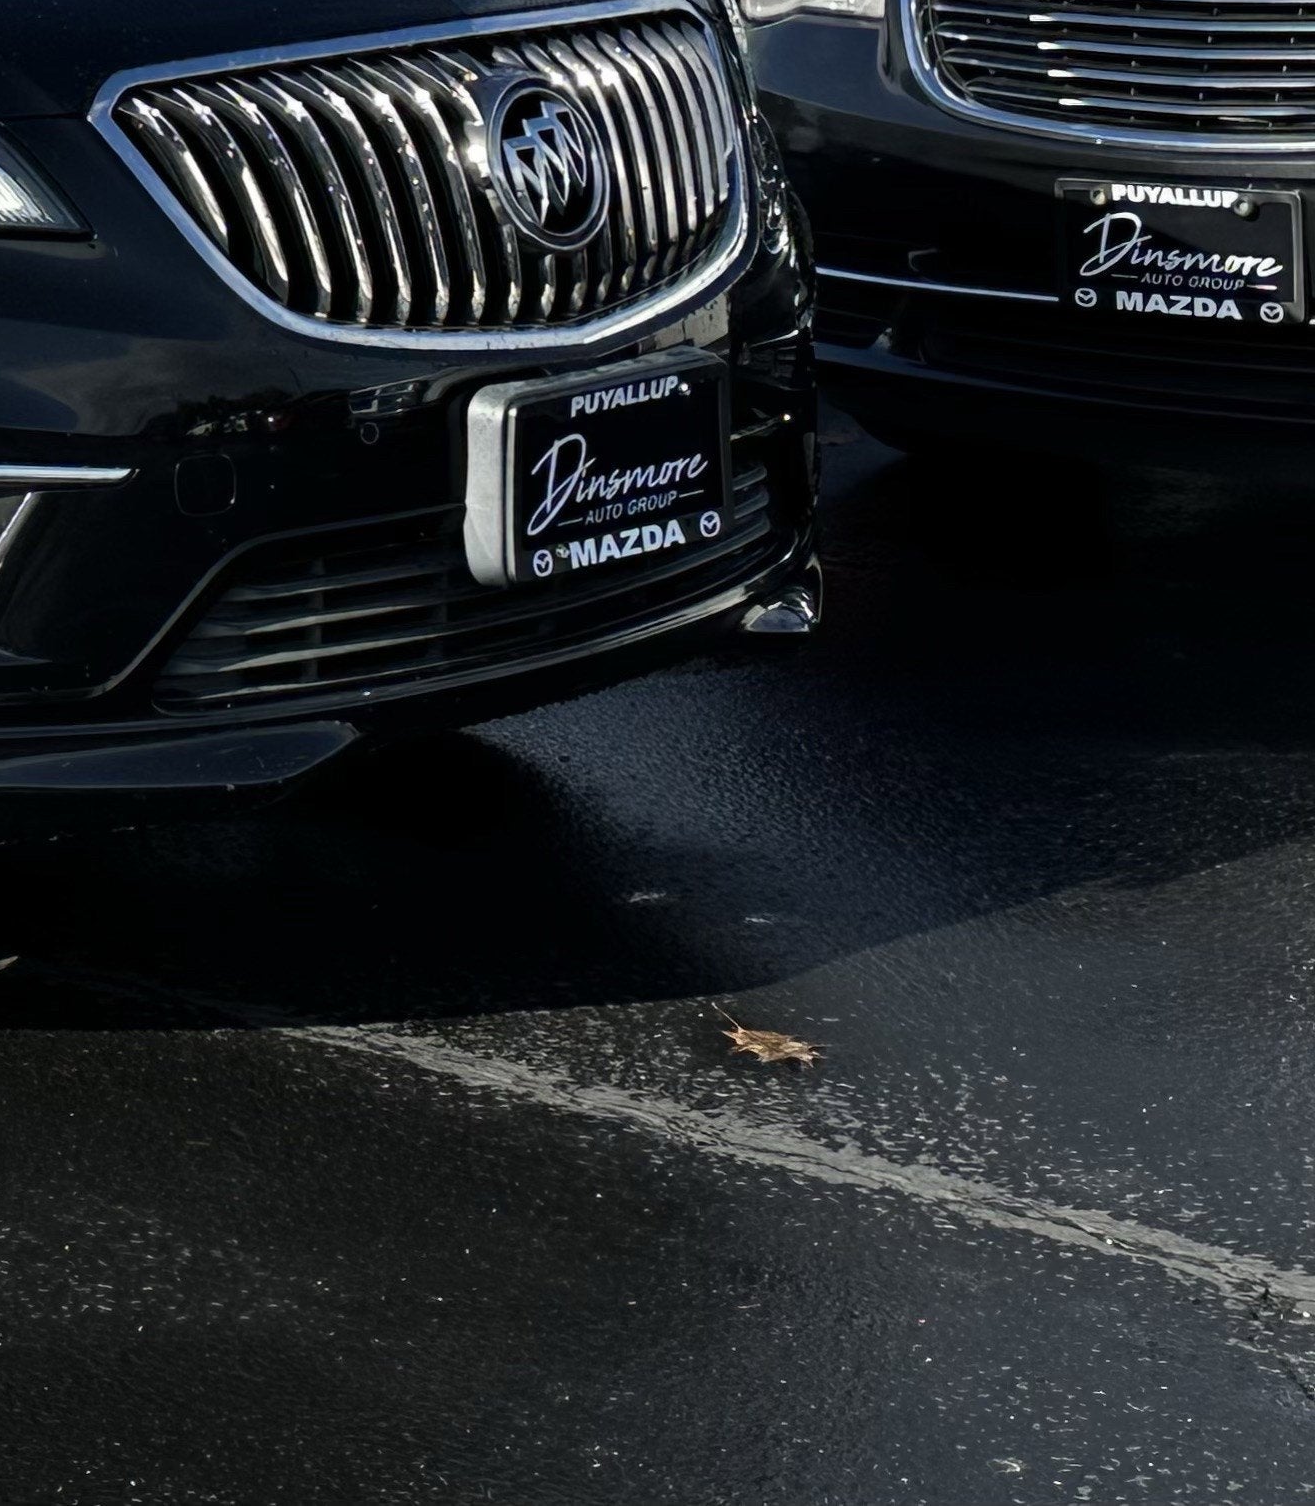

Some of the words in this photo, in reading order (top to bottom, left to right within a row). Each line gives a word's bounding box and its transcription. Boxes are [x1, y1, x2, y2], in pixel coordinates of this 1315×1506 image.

[1111, 184, 1238, 208] PUYALLUP
[1080, 212, 1283, 277] Dinsmore
[1141, 272, 1184, 286] AUTO
[1188, 275, 1245, 291] GROUP
[1116, 291, 1242, 320] MAZDA
[571, 375, 679, 418] PUYALLUP
[526, 433, 709, 536] Dinsmore
[585, 503, 623, 526] AUTO
[627, 490, 678, 518] GROUP
[570, 519, 686, 569] MAZDA
